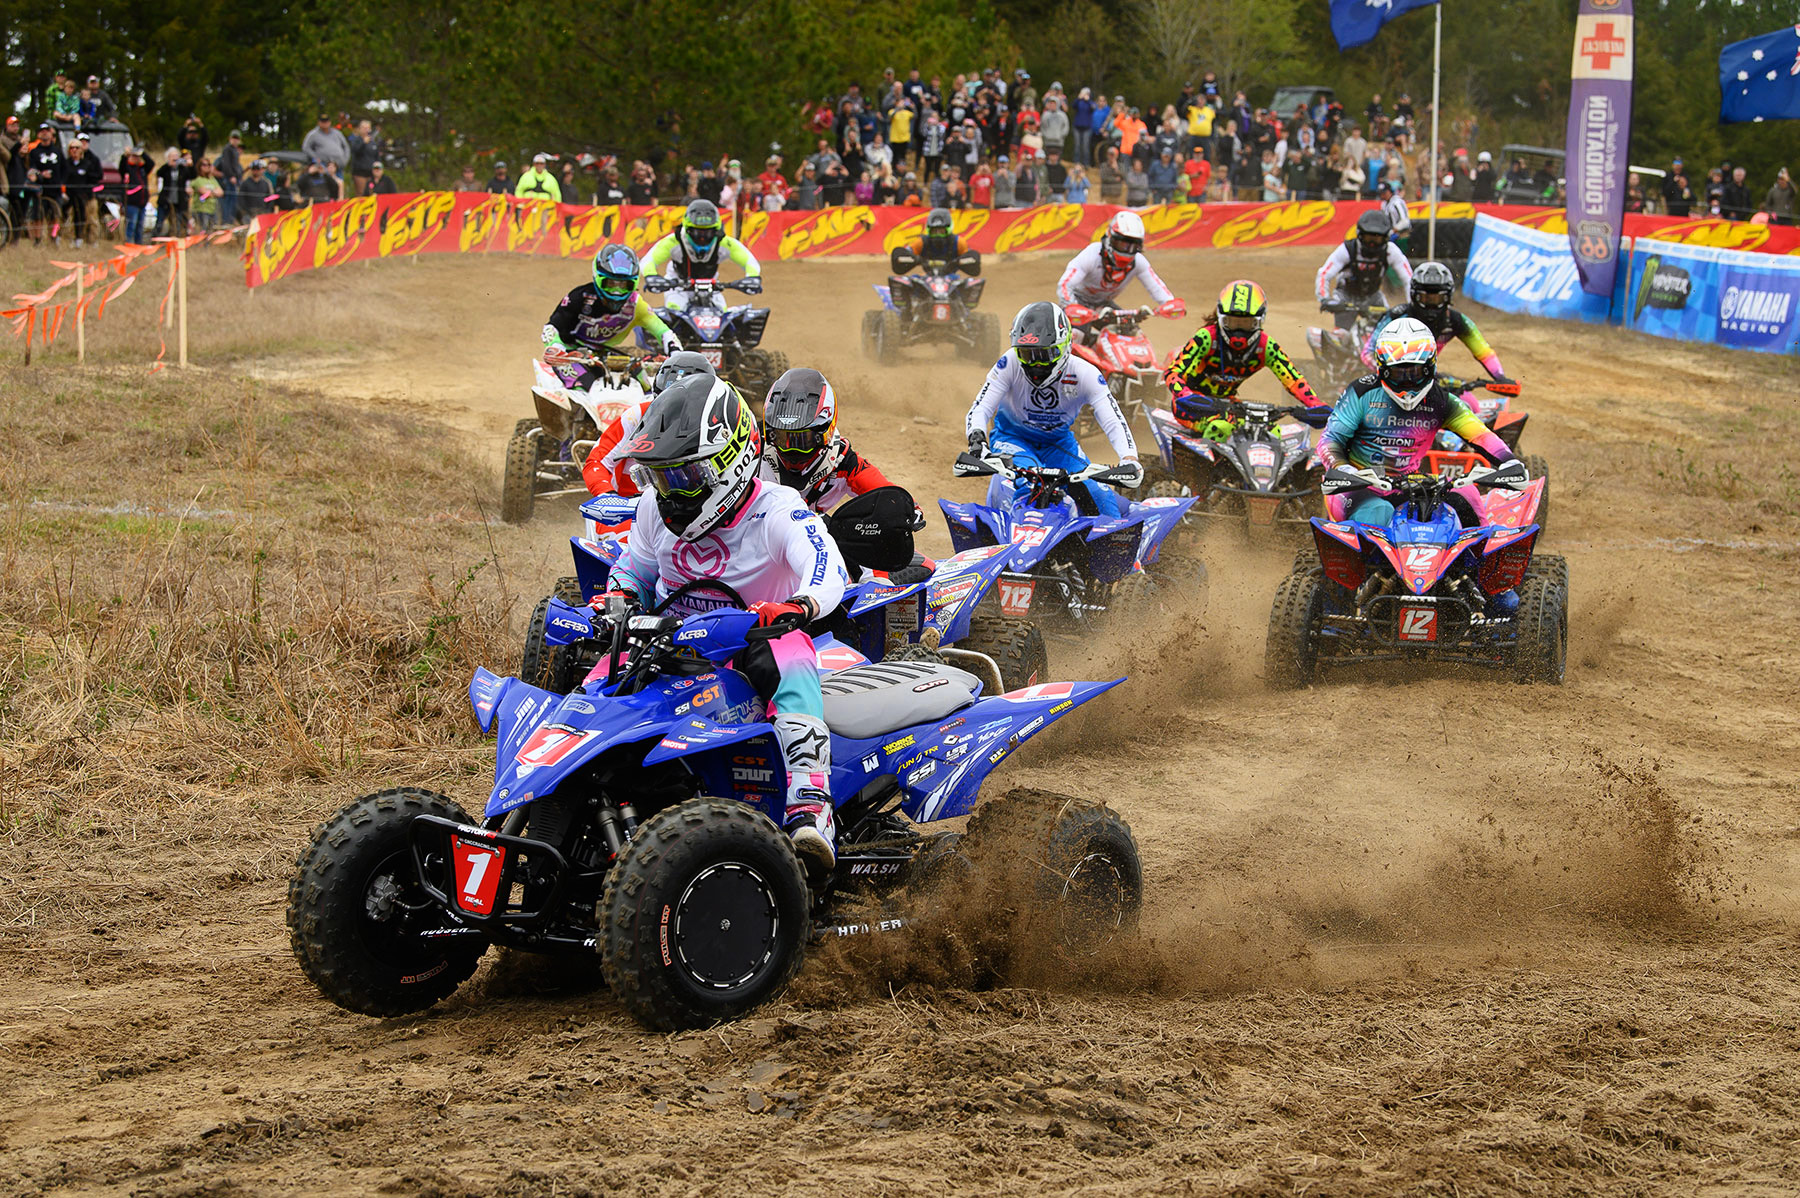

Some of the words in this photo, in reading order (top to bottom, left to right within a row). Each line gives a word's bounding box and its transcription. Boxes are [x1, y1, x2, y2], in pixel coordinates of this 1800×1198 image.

[778, 206, 875, 260] FMF
[884, 209, 989, 255] FF
[995, 203, 1084, 253] FMF
[1211, 201, 1335, 247] FMF
[1235, 284, 1250, 311] FXR
[1735, 289, 1791, 323] YAMAHA
[1721, 320, 1779, 335] RACING
[1366, 414, 1384, 427] Fly
[733, 444, 757, 477] 001
[1438, 464, 1464, 479] 703
[809, 467, 829, 484] LEATT
[1012, 530, 1044, 544] 712
[1406, 549, 1438, 566] 12
[933, 581, 974, 599] MAXXIS
[1001, 585, 1032, 609] 712
[1401, 609, 1435, 634] 12
[692, 685, 720, 707] CST
[675, 702, 690, 716] SSI
[712, 700, 753, 724] HOENIX
[523, 733, 570, 760] 1
[662, 740, 688, 749] MOTUL
[883, 734, 914, 752] WORKS
[732, 756, 767, 765] CST
[732, 767, 773, 782] DWT
[908, 759, 936, 786] SSI
[463, 852, 492, 895] 1
[850, 863, 900, 875] WALSH
[660, 925, 671, 966] PULSE
